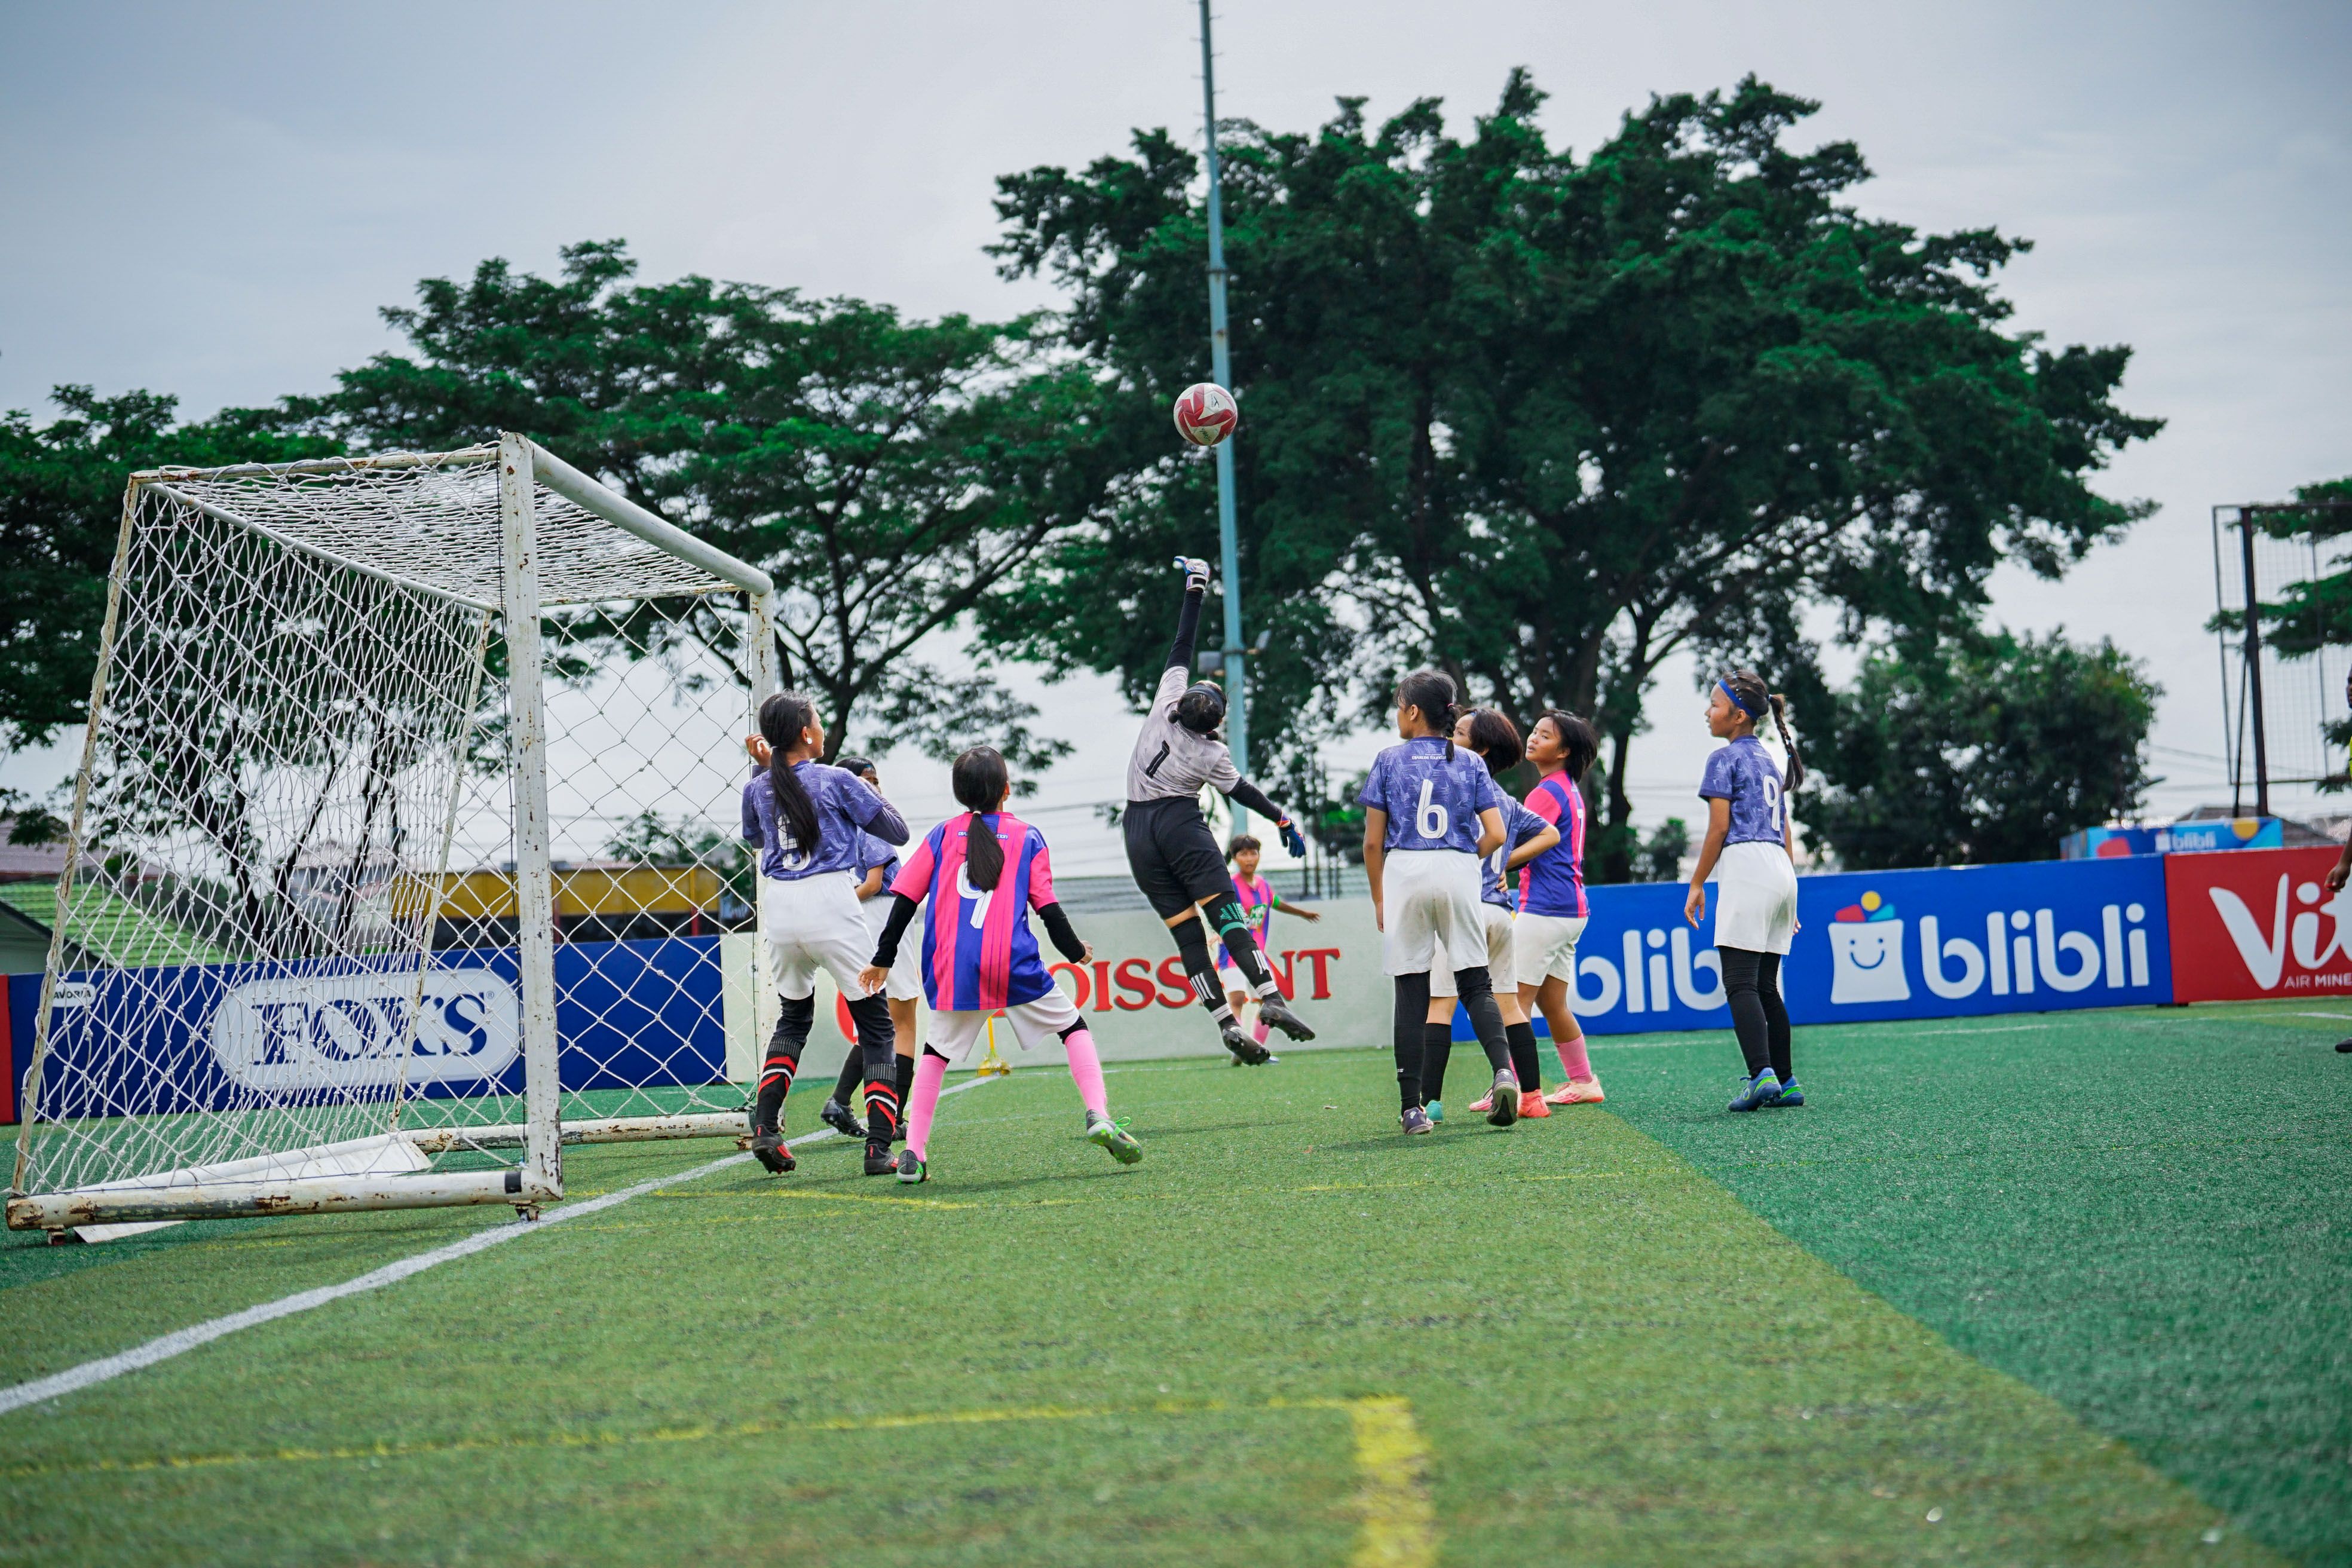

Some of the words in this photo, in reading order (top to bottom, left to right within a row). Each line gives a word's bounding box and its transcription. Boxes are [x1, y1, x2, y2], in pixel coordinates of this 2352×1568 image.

[1146, 739, 1170, 779] 1
[1416, 779, 1448, 839] 6
[1763, 774, 1780, 831] 9
[956, 860, 994, 929] 9
[1919, 902, 2150, 1000] blibli
[2284, 974, 2311, 989] AIR
[251, 991, 488, 1066] FOX'S
